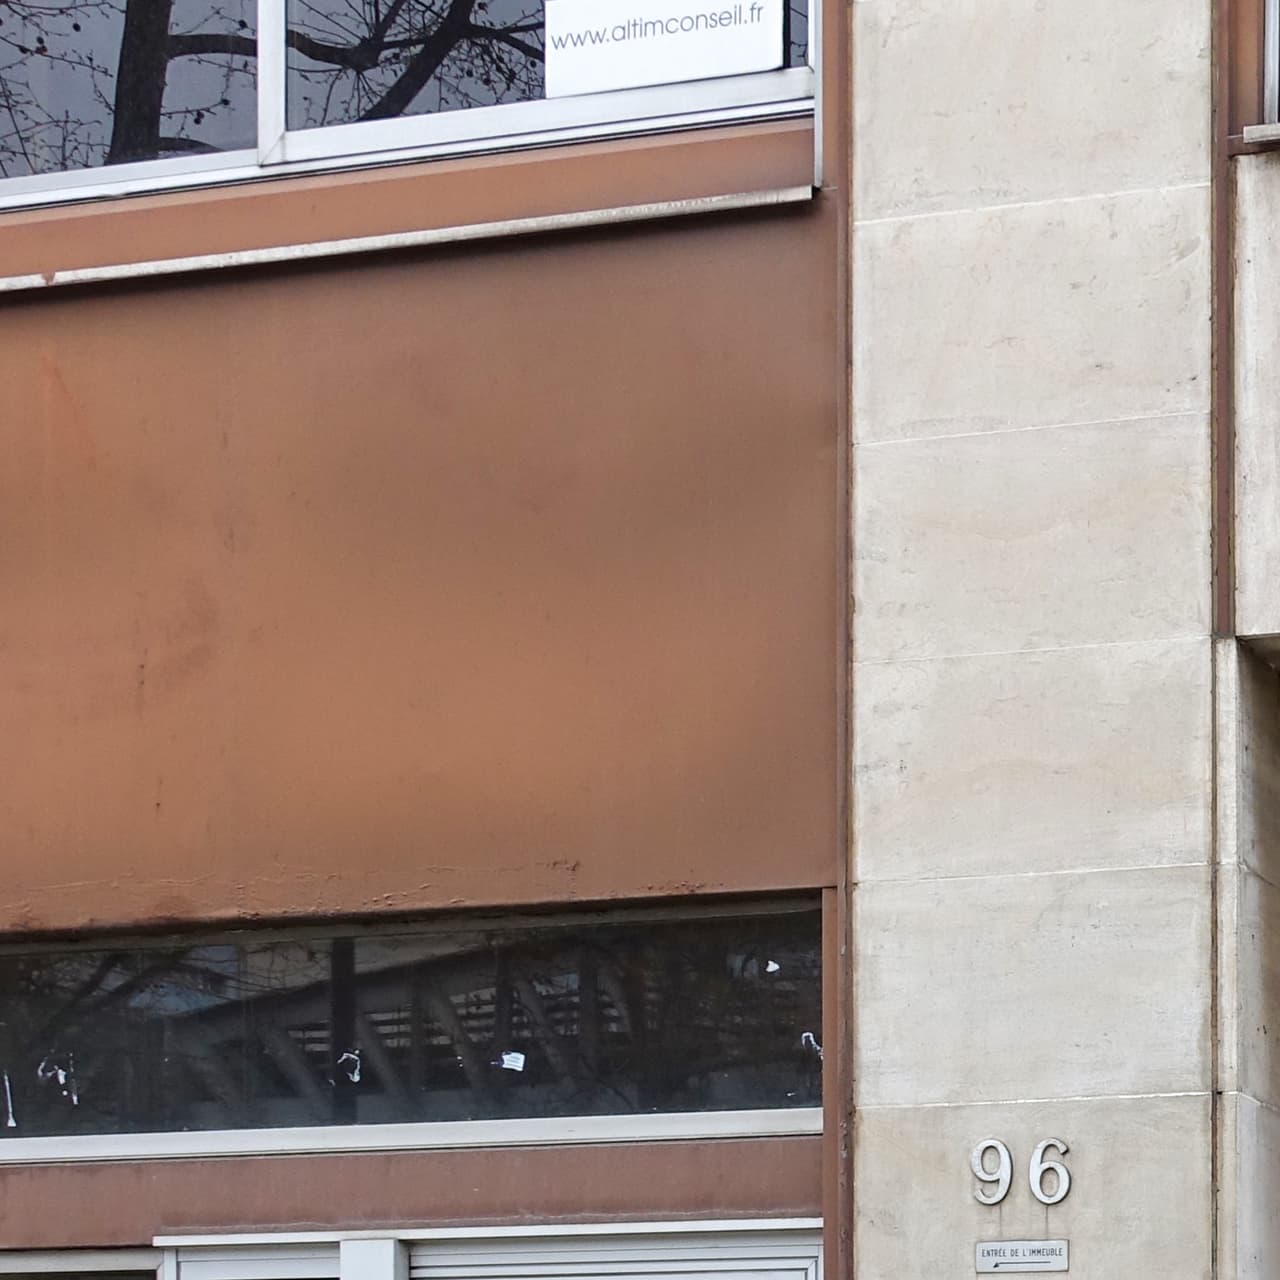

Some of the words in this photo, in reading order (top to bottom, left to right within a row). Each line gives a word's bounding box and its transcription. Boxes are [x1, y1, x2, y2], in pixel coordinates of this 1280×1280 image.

[551, 3, 764, 51] www.altimconseil.fr
[970, 1137, 1071, 1206] 96
[1010, 1248, 1019, 1257] DE
[1022, 1247, 1063, 1257] L'IMMEUBLE
